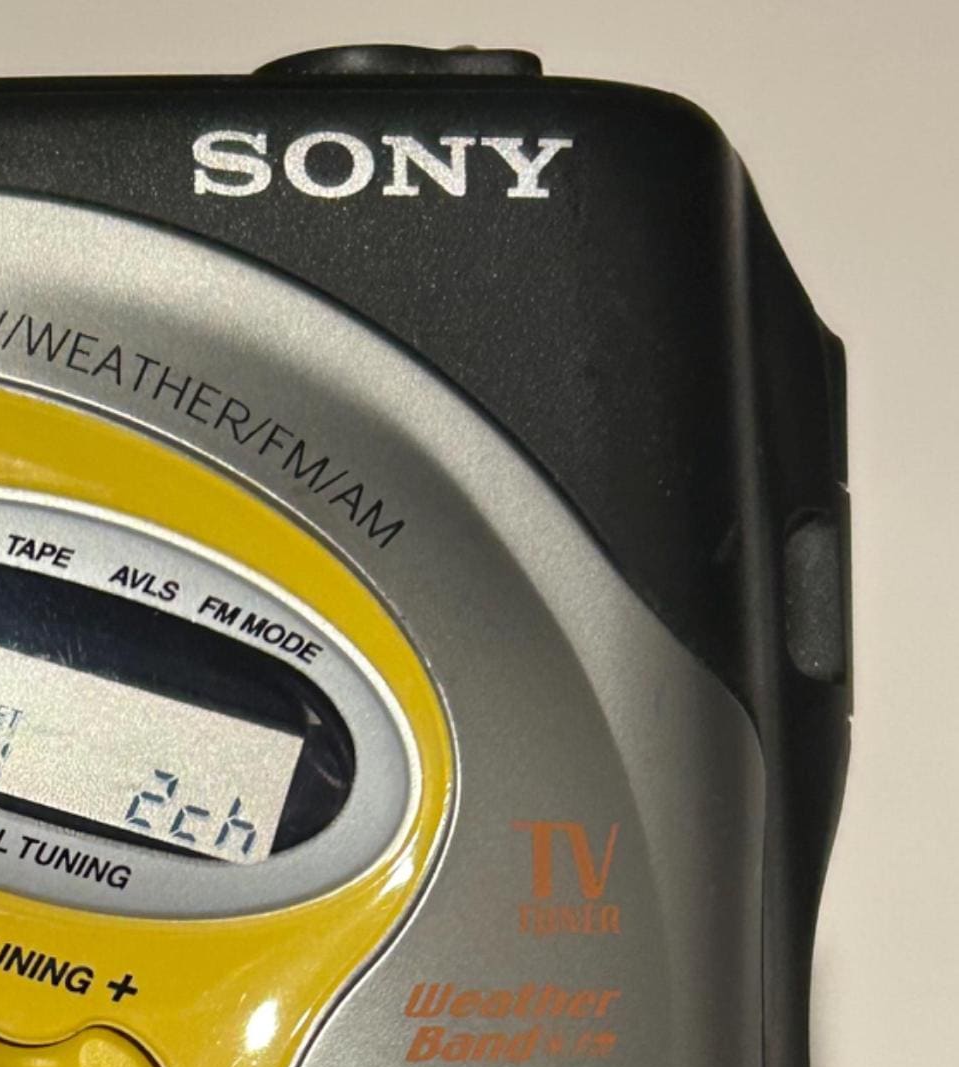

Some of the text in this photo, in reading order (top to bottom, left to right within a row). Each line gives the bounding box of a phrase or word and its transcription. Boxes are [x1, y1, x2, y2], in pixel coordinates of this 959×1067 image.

[192, 130, 572, 198] SONY
[6, 535, 75, 568] TAPE
[108, 566, 180, 601] AVLS
[198, 595, 323, 664] FM MODE
[17, 835, 133, 890] TUNING
[511, 820, 621, 899] TV
[404, 981, 621, 1019] Weather
[405, 1024, 541, 1064] Band
